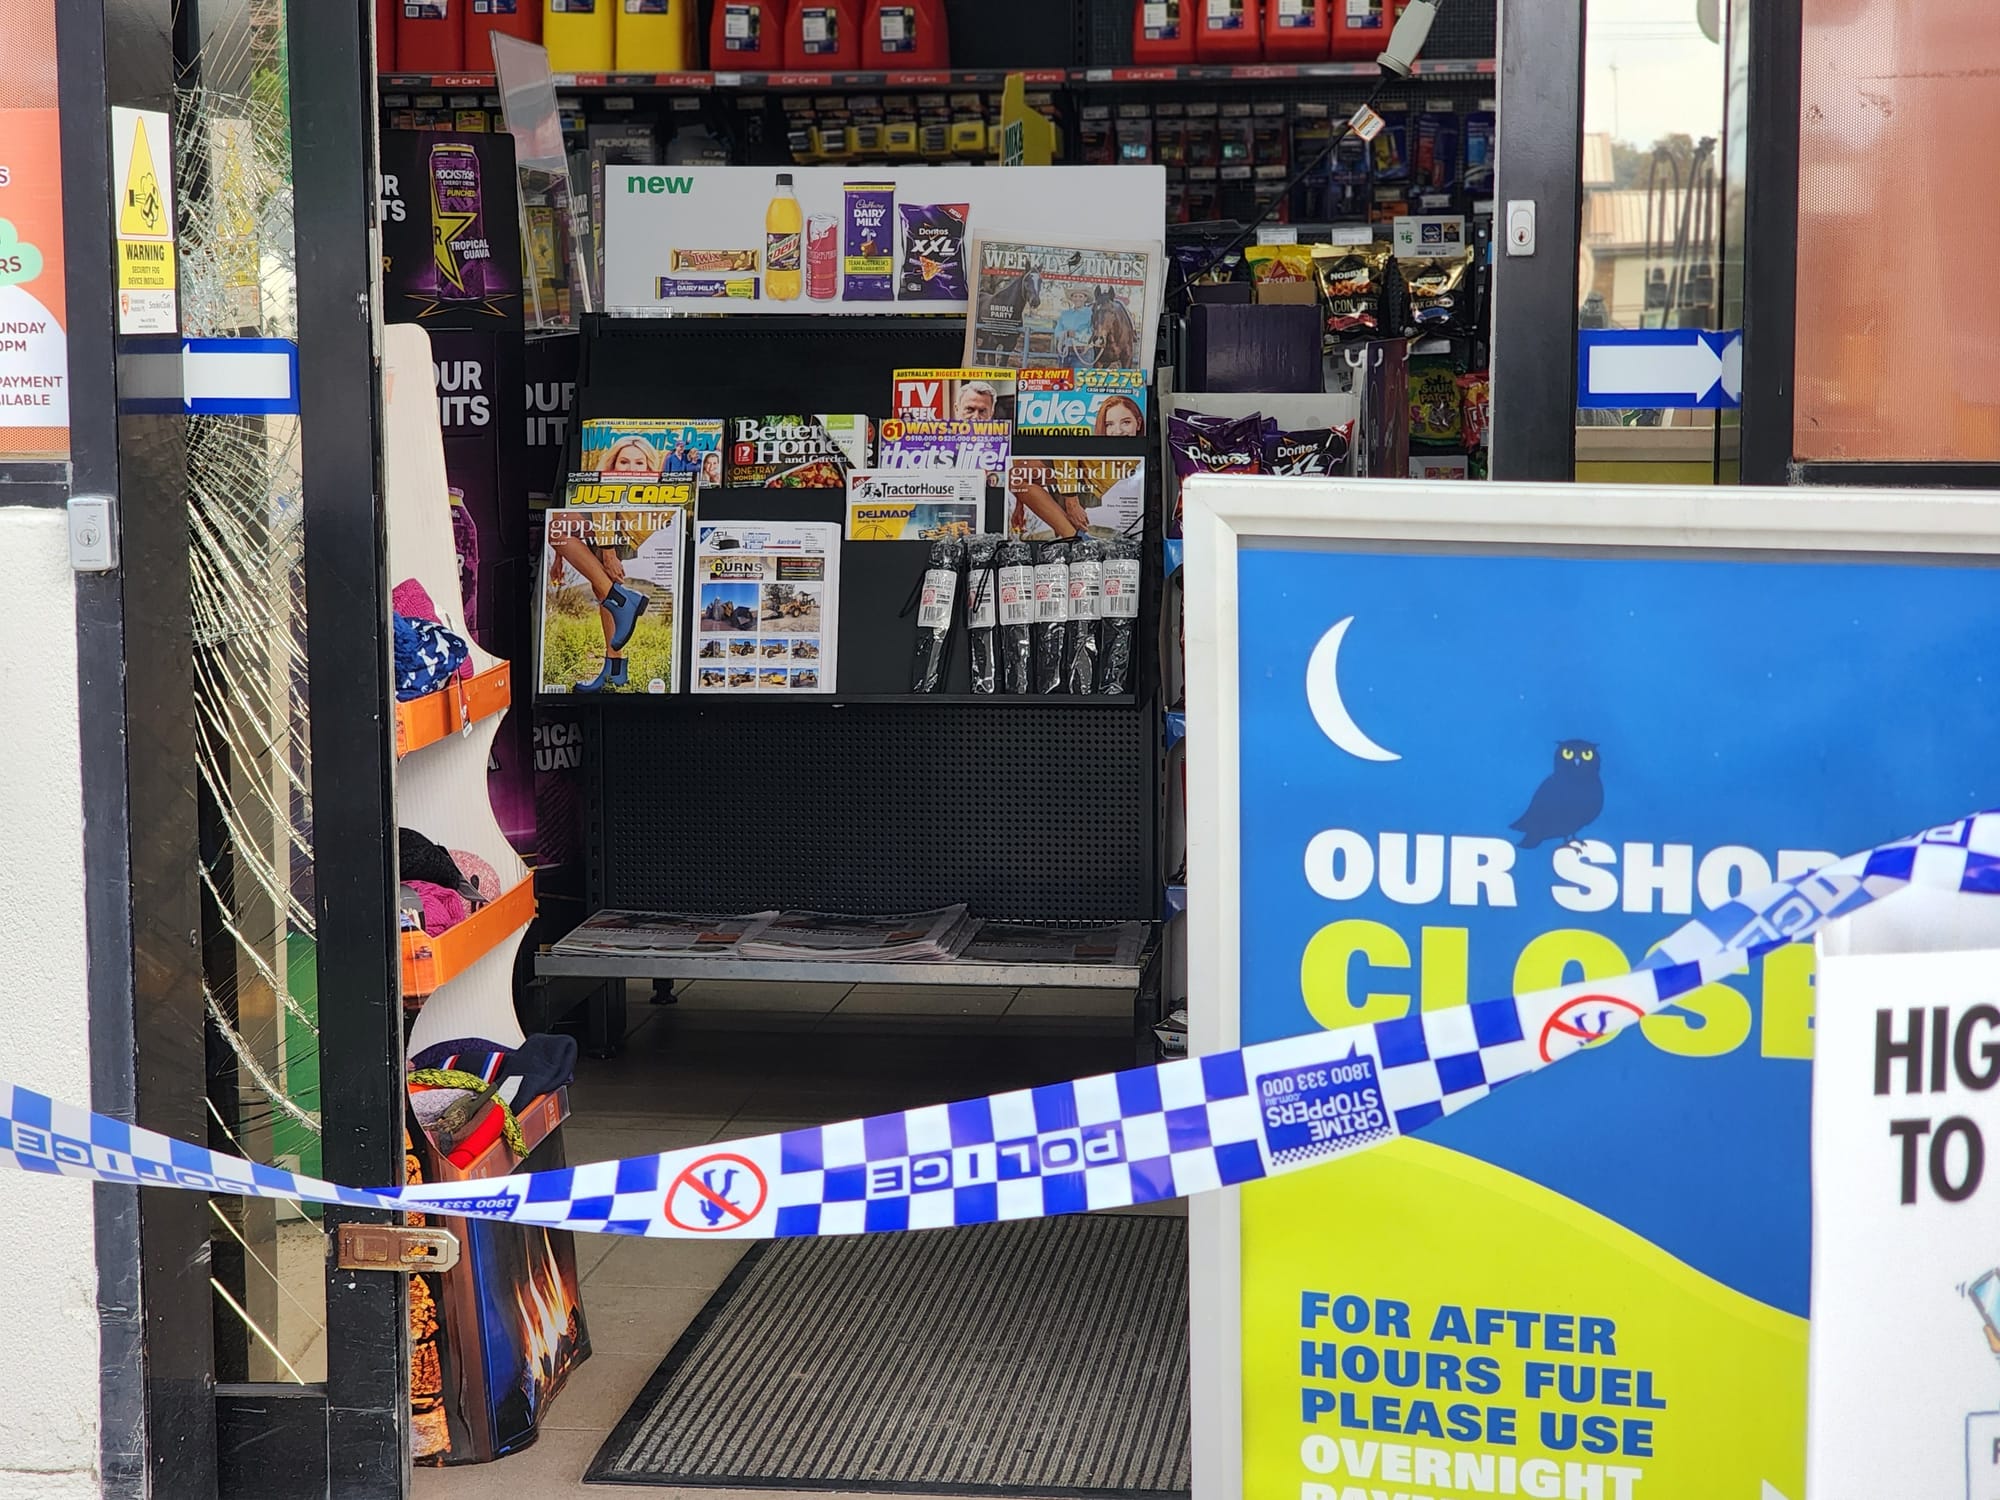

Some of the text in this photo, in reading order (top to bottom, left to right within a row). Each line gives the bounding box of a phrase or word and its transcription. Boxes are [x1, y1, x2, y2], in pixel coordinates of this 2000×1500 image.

[445, 77, 481, 85] Car Care
[436, 169, 475, 180] ROCKSTAR
[628, 175, 694, 194] new
[447, 189, 476, 197] PUNCHED
[853, 208, 887, 219] DAIRY
[855, 217, 882, 227] MILK
[918, 227, 949, 236] Doritos
[126, 243, 165, 261] WARNING
[450, 239, 489, 251] TROPICAL
[910, 236, 957, 256] XXL
[463, 248, 491, 260] GUAVA
[985, 250, 1144, 279] WEEKLY TIMES
[677, 284, 715, 292] DAIRY MILK
[990, 304, 1014, 313] BRIDLE
[990, 311, 1013, 319] PARTY
[1020, 369, 1070, 379] LET'S KNIT!
[898, 381, 940, 407] TV
[1420, 383, 1453, 394] SOUR
[0, 394, 50, 406] ILABLE
[1420, 393, 1454, 405] PATCH
[1017, 392, 1087, 425] Take
[736, 419, 824, 442] Better
[882, 421, 904, 439] 61
[905, 421, 1009, 436] WAYS TO WIN!
[1018, 428, 1091, 436] MUM COOKED
[589, 426, 722, 451] Won's Day
[880, 441, 1008, 471] that's life!
[1276, 442, 1319, 458] Doritos
[733, 465, 777, 476] ONE-TRAY
[1010, 461, 1136, 486] gippsland life
[570, 484, 690, 504] JUST CARS
[881, 482, 955, 498] TractorHouse
[1042, 479, 1098, 494] winter
[857, 509, 917, 519] DELMADE
[550, 511, 674, 539] gippsland life
[581, 531, 634, 546] winter
[714, 562, 763, 572] BURNS
[1304, 828, 1518, 908] OUR
[1262, 1062, 1372, 1097] 1800 333 000
[1266, 1088, 1379, 1128] STOPPERS
[1307, 1108, 1384, 1141] CRIME
[16, 1126, 258, 1194] POLICE
[872, 1127, 1120, 1194] POLICE
[1889, 1114, 1985, 1205] TO
[443, 1197, 515, 1210] 1800 333
[1301, 1291, 1617, 1356] FOR AFTER
[1301, 1340, 1667, 1409] HOURS FUEL
[1301, 1387, 1654, 1457] PLEASE USE
[1300, 1434, 1643, 1500] OVERNIGHT
